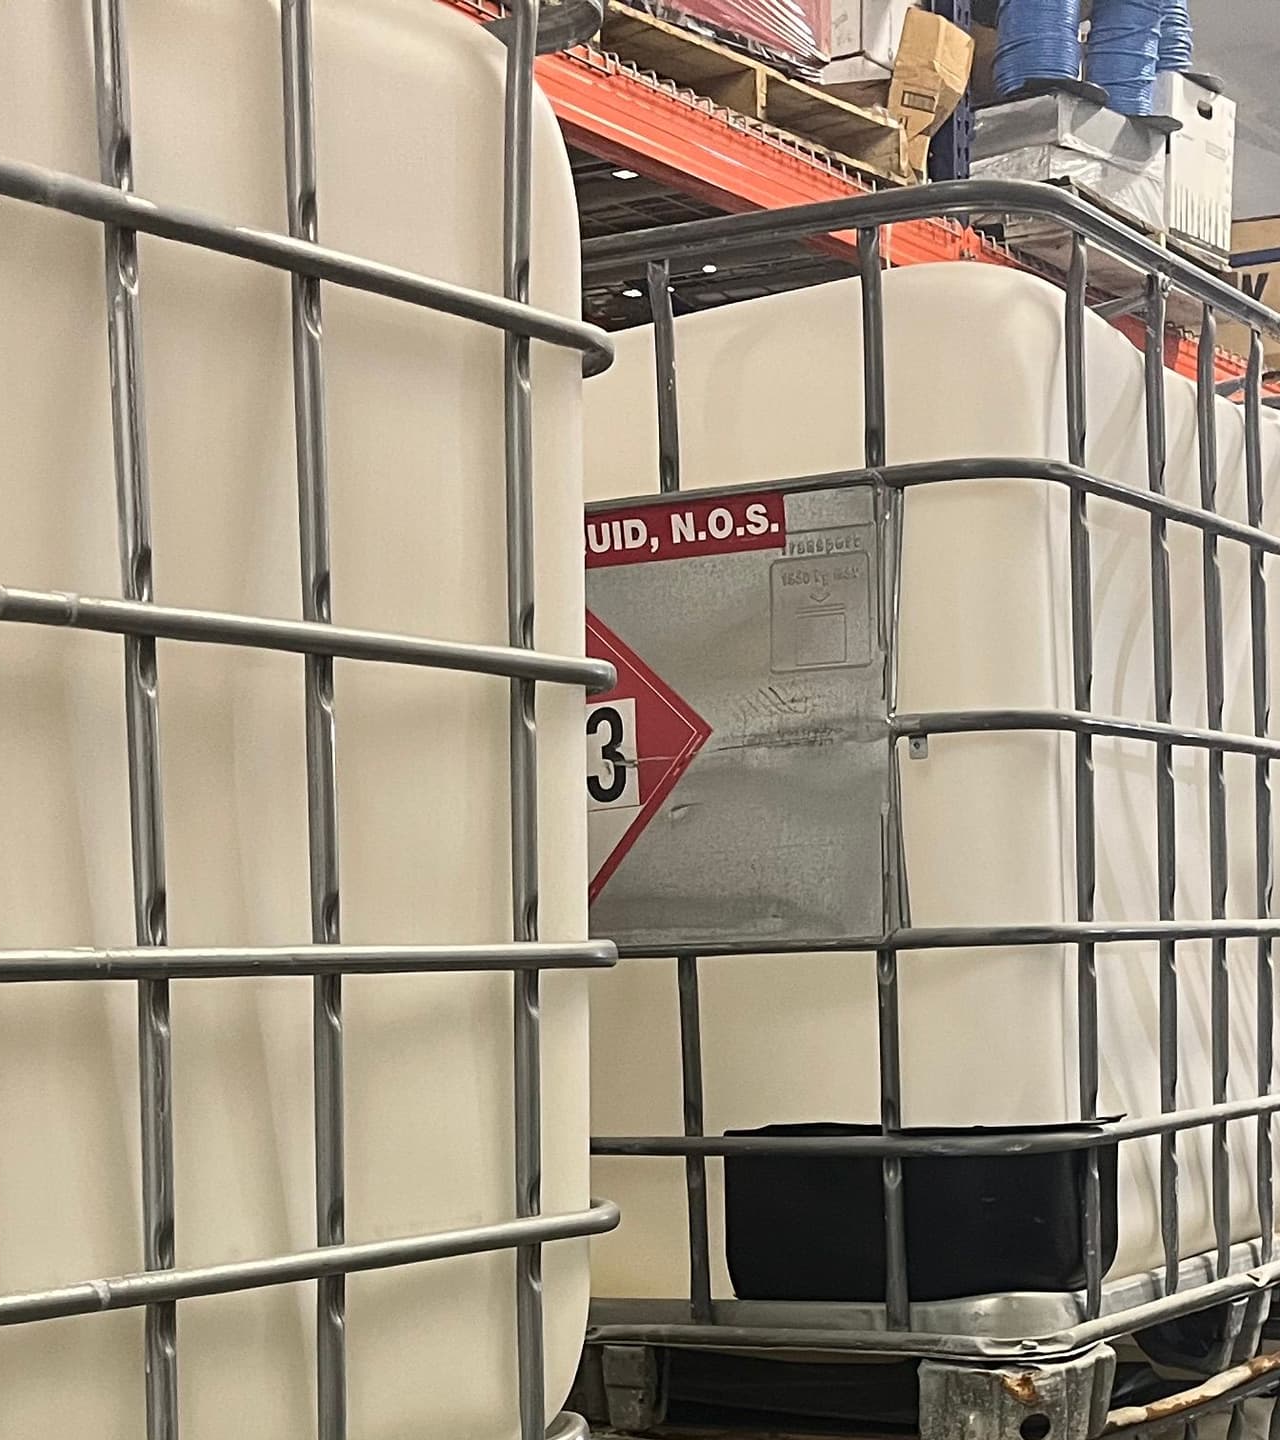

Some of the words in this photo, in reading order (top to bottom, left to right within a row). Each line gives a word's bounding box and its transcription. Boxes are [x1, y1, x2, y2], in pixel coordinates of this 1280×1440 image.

[586, 518, 660, 554] UID,
[670, 503, 780, 544] N.O.S.
[586, 706, 627, 803] 3
